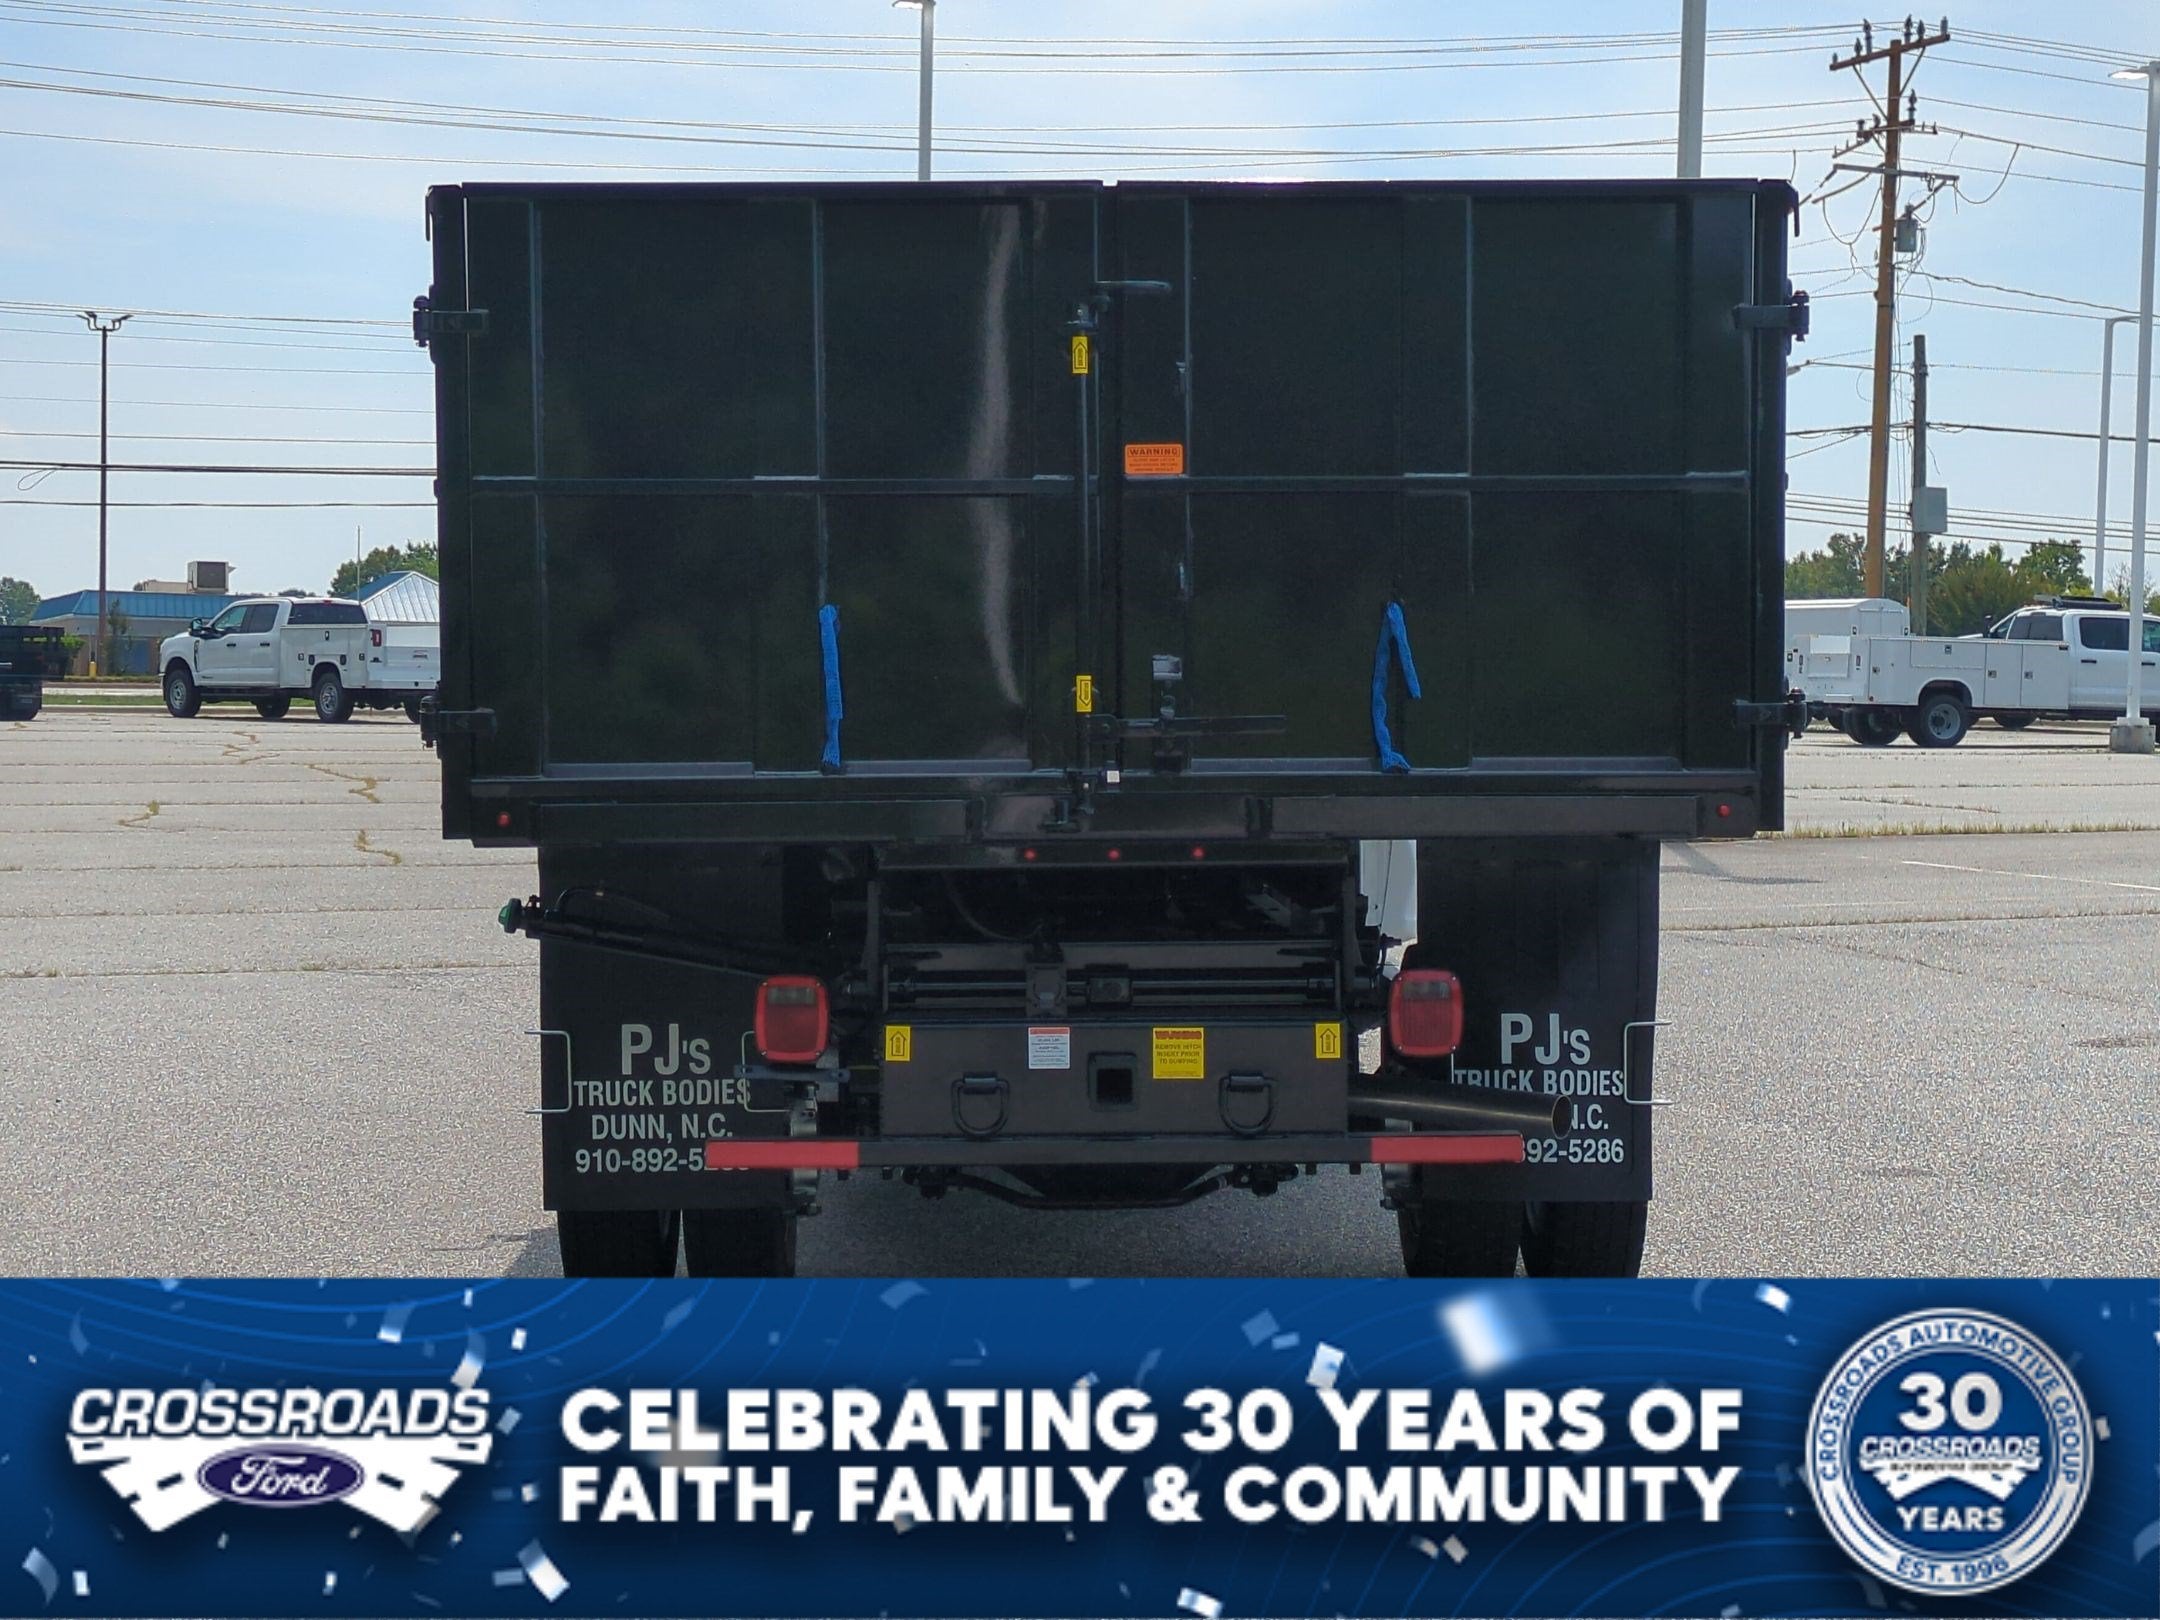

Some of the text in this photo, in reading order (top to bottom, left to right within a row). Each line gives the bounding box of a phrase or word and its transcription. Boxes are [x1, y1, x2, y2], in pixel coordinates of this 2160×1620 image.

[1129, 448, 1178, 456] WARNING
[574, 1079, 751, 1106] TRUCK BODIES
[1454, 1069, 1625, 1096] TRUCK BODIES
[592, 1113, 733, 1144] DUNN, N.C.
[575, 1148, 749, 1173] 910-892-5
